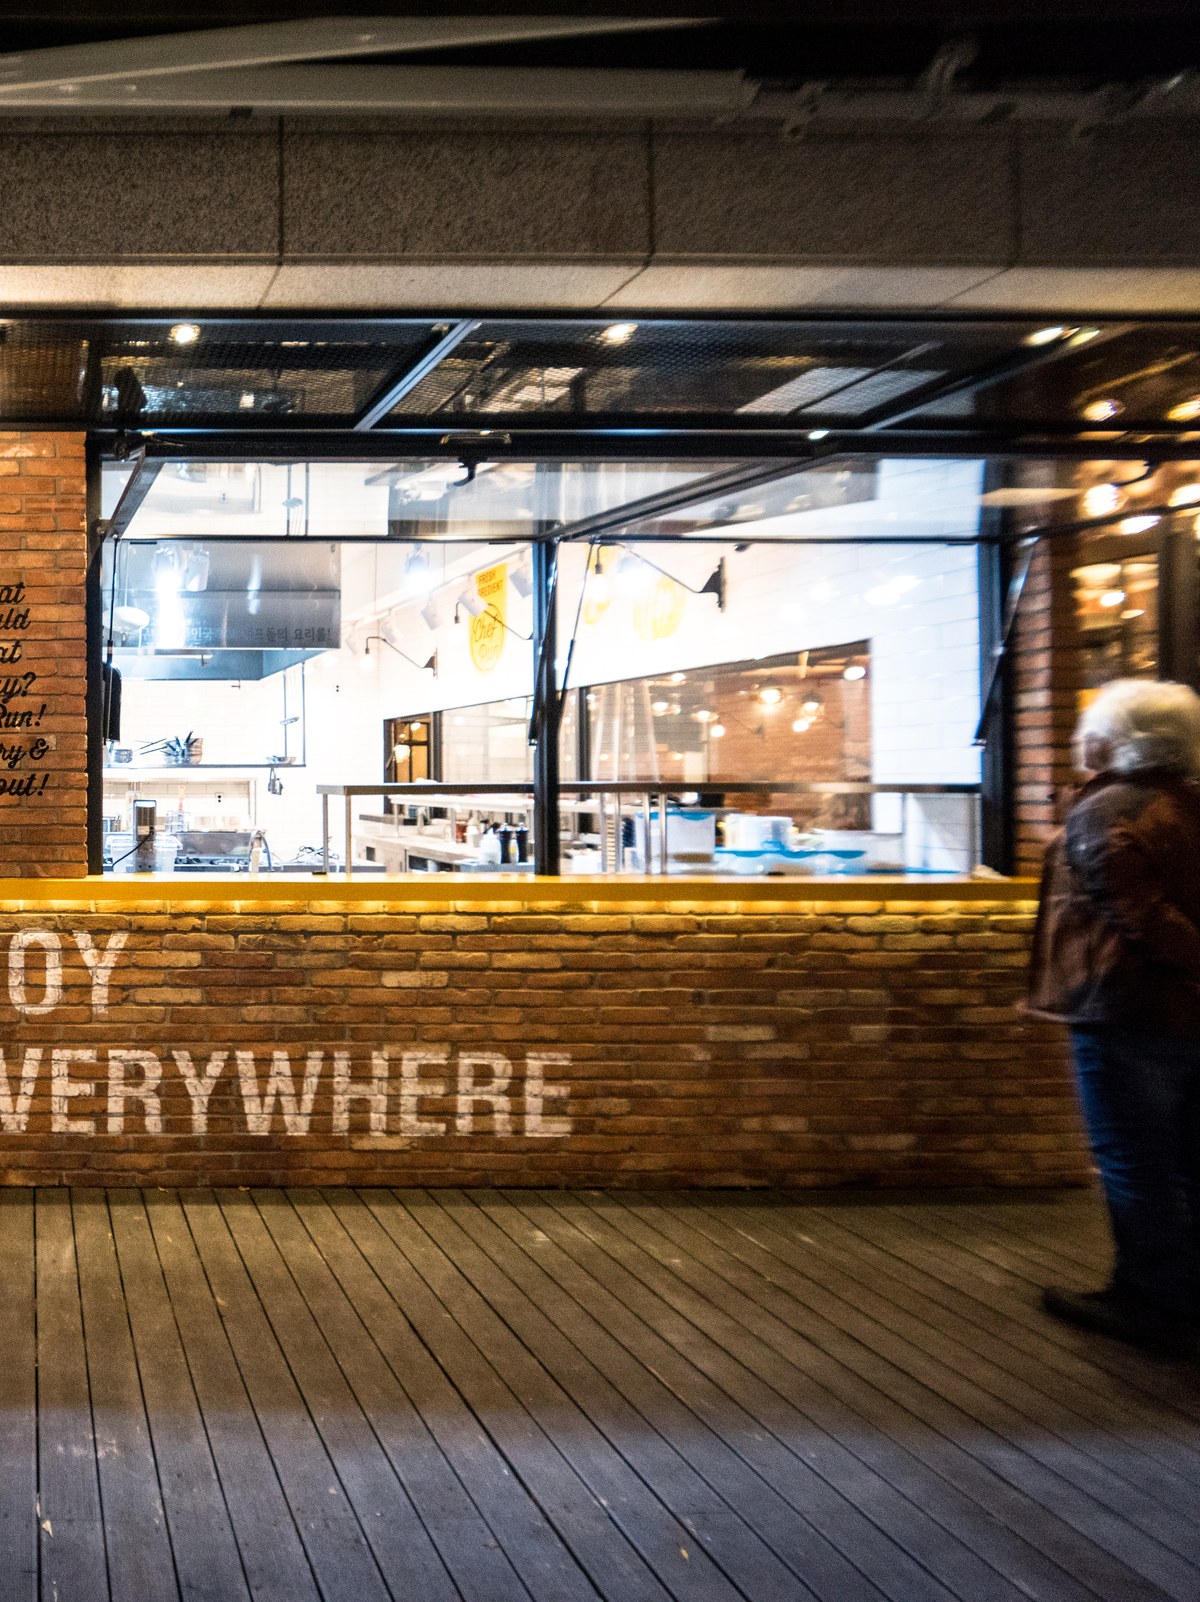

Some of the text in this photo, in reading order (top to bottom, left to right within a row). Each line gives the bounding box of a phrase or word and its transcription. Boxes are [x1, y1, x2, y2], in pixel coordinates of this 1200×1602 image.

[479, 571, 497, 584] FRESH
[472, 612, 499, 643] Chef
[29, 738, 49, 761] &
